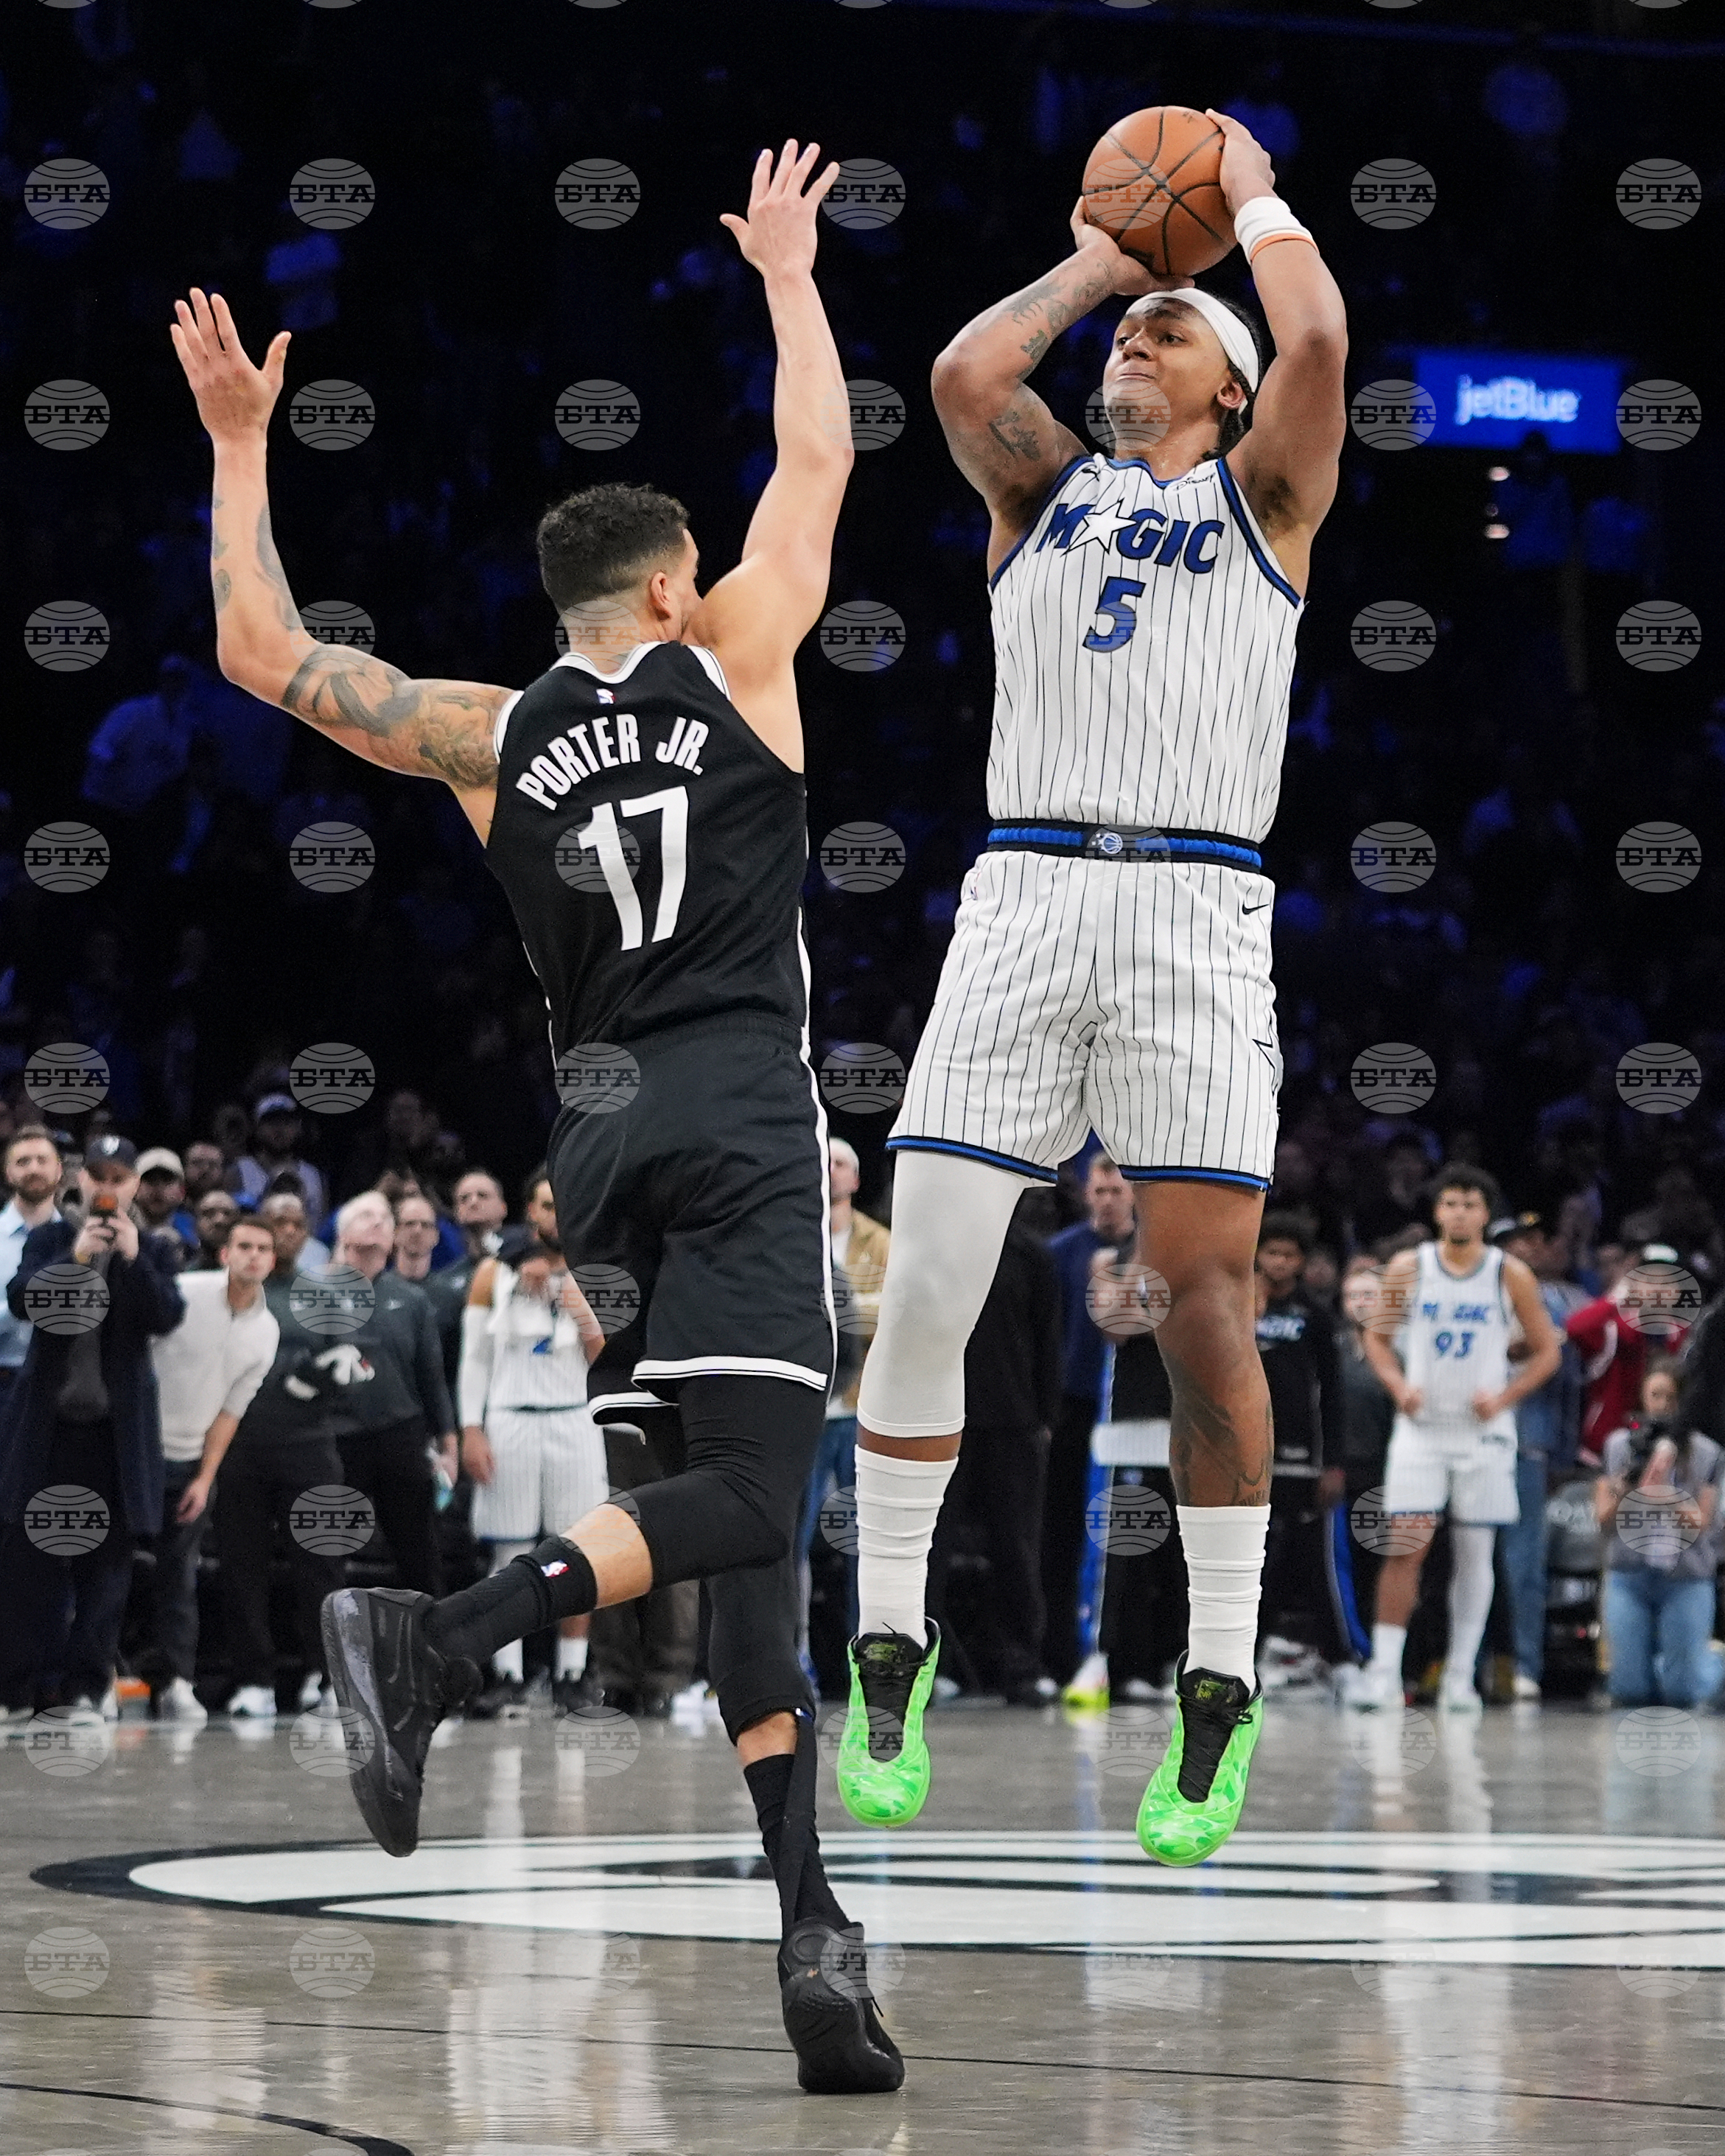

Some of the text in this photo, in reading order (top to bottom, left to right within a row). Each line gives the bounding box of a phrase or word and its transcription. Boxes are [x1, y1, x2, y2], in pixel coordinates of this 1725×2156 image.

[1455, 374, 1581, 425] jetBlue
[1082, 575, 1147, 653] 5
[516, 713, 709, 811] PORTER JR.
[577, 785, 689, 951] 17
